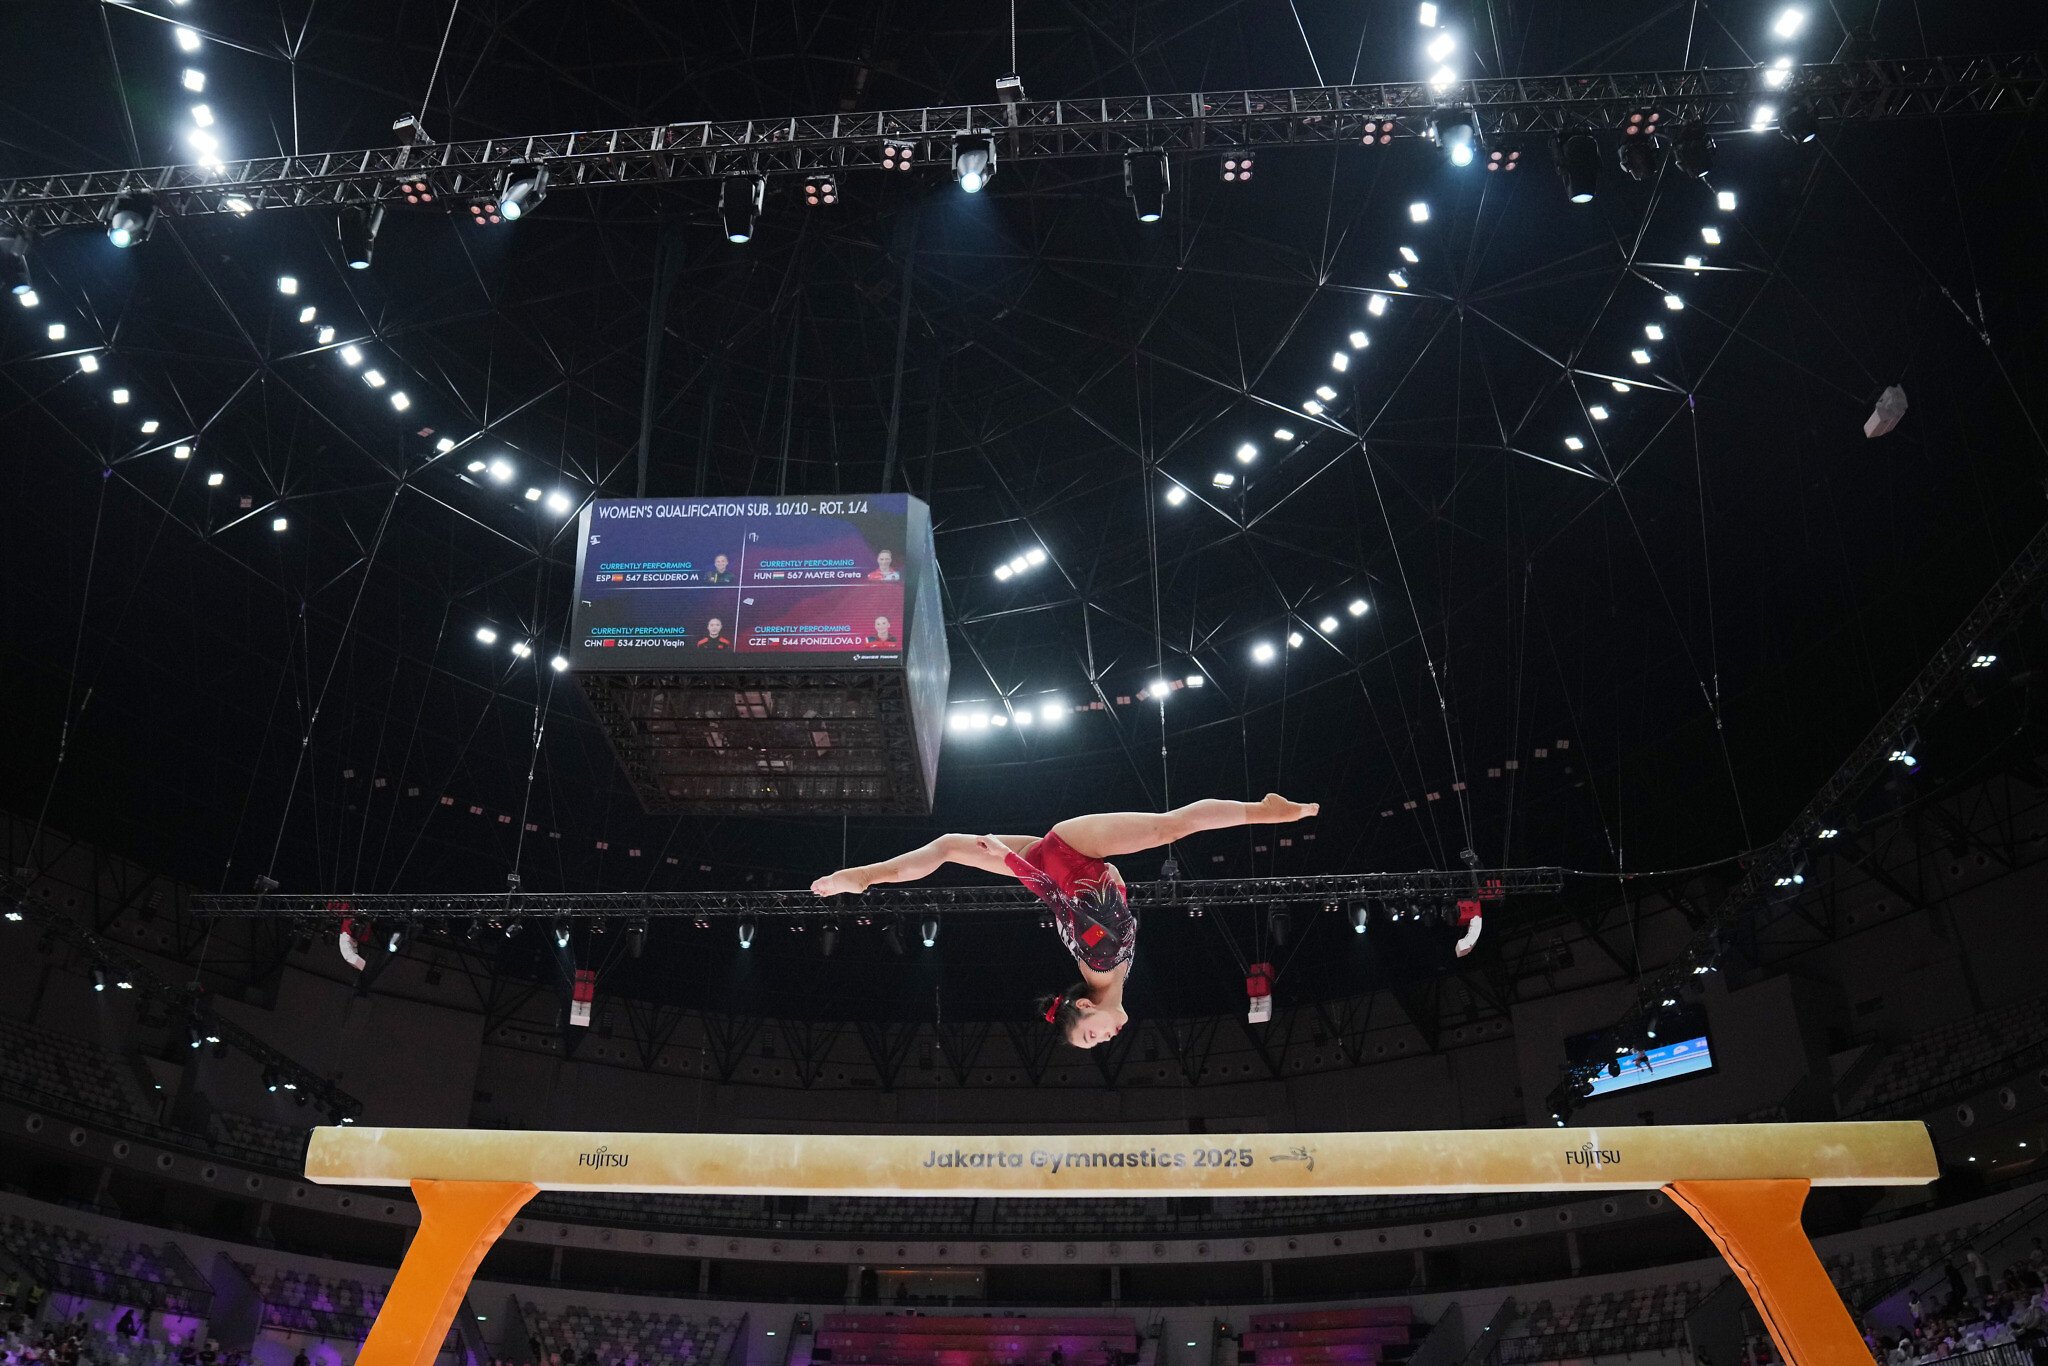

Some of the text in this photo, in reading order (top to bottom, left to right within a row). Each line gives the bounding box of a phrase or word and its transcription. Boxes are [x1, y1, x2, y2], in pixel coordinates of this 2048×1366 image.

[599, 505, 652, 518] WOMEN'S
[655, 504, 745, 517] QUALIFICATION
[747, 503, 772, 516] SUB.
[775, 502, 808, 515] 10/10
[819, 502, 844, 515] ROT.
[848, 501, 868, 514] 1/4
[600, 561, 692, 570] CURRENTLY PERFORMING
[760, 559, 854, 568] CURRENTLY PERFORMING
[596, 573, 699, 582] ESP 547 ESCUDERO M
[754, 572, 771, 580] HUN
[804, 571, 835, 579] MAYER
[837, 571, 861, 579] Greta
[591, 626, 685, 635] CURRENTLY PERFORMING
[754, 625, 851, 633] CURRENTLY PERFORMING
[584, 639, 685, 649] CHN 534 ZHOU Yaqin
[748, 637, 862, 646] CZE 544 PONIZILOVA D
[579, 1147, 629, 1170] FUJITSU
[1565, 1143, 1621, 1168] FUJITSU
[923, 1148, 1254, 1173] Jakarta Gymnastics 2025
